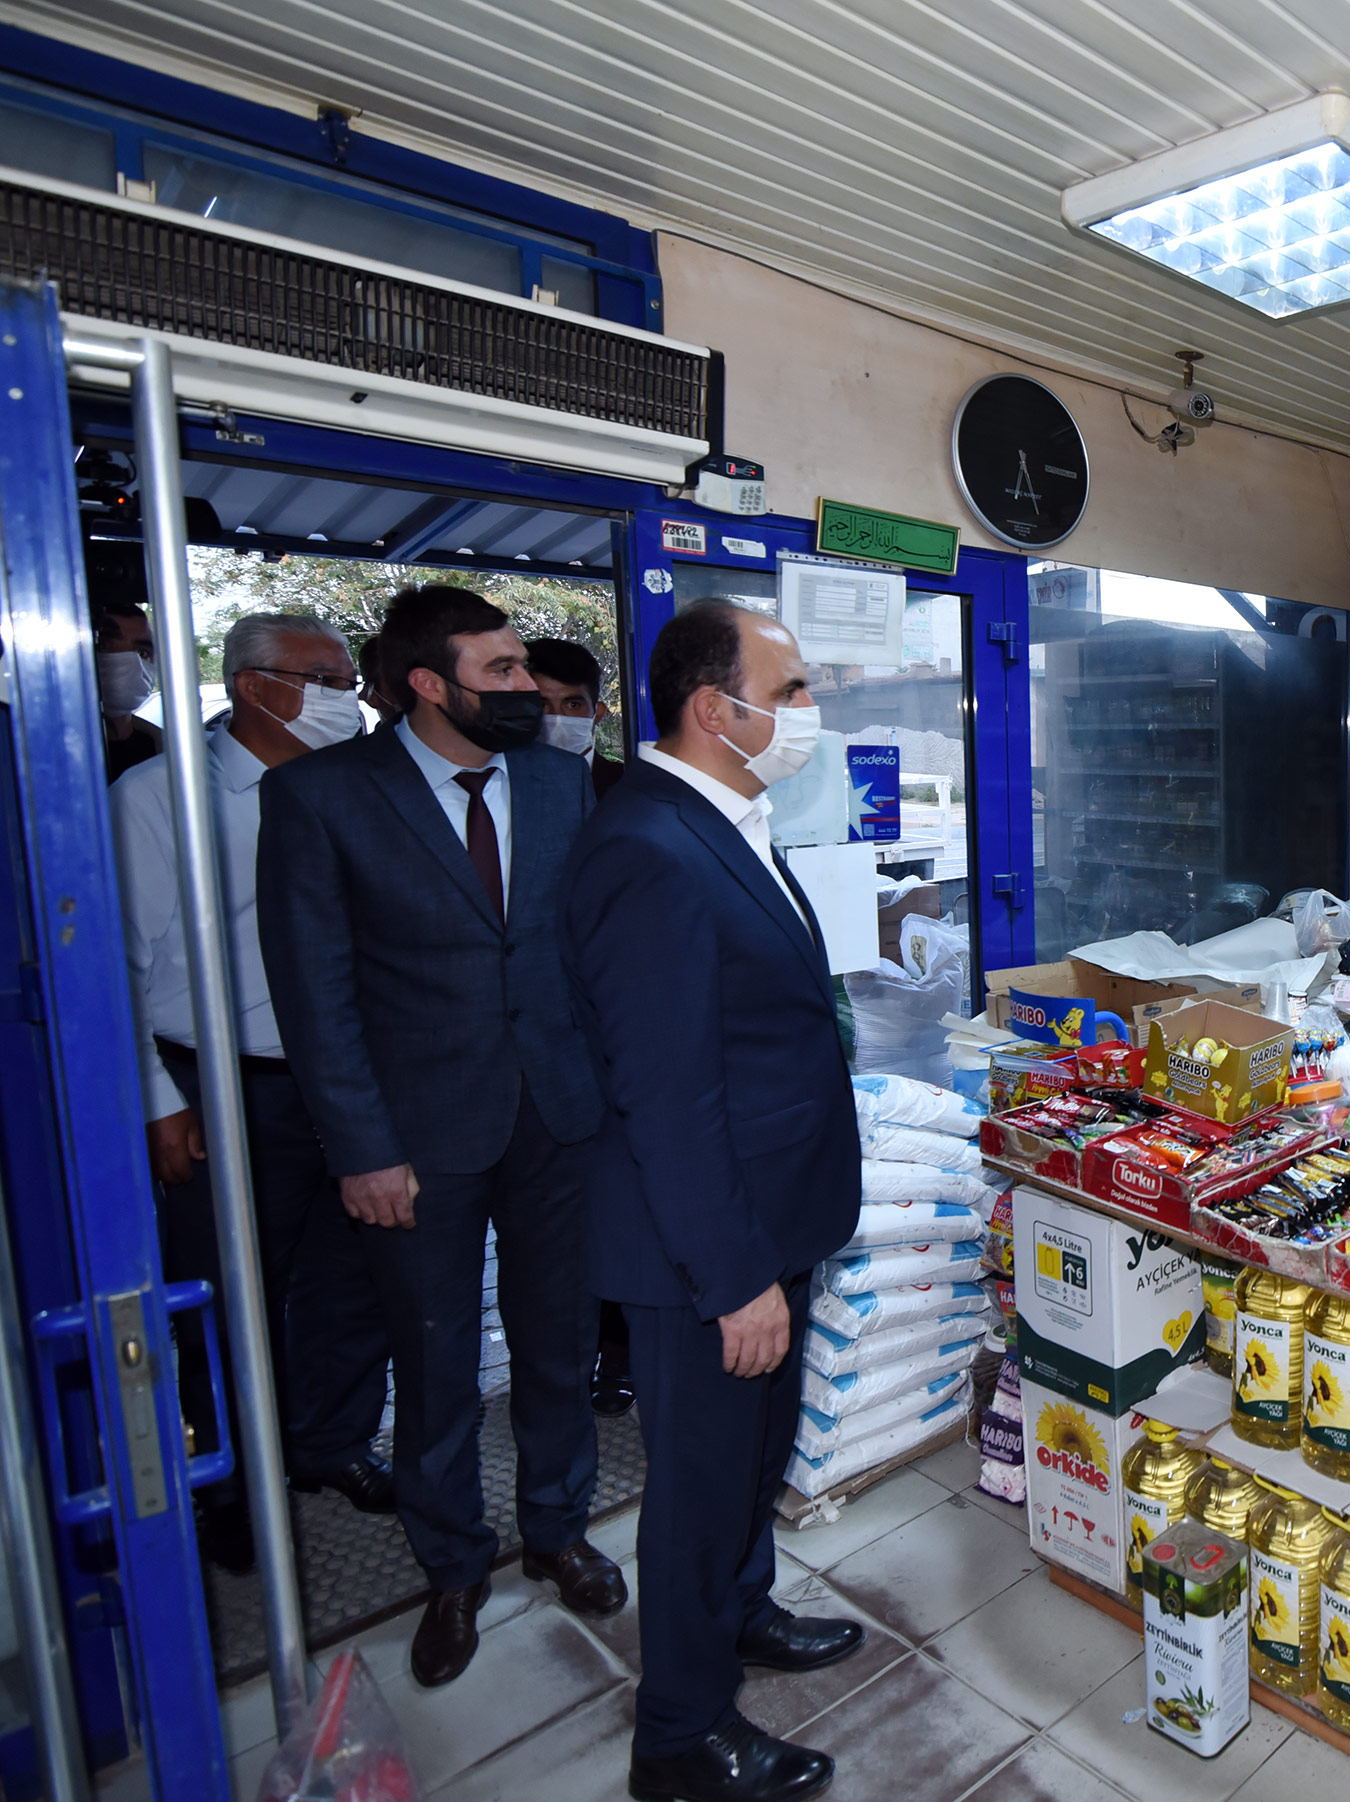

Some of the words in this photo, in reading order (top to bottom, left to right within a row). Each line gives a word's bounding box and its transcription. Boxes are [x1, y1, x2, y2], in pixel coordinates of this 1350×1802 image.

[852, 754, 897, 766] sodexo
[1250, 1040, 1285, 1069] HARIBO
[1168, 1054, 1211, 1080] HARIBO
[1250, 1060, 1281, 1082] Goldbears
[1031, 1071, 1066, 1088] HARIBO
[1169, 1069, 1208, 1090] Goldbears
[1119, 1163, 1156, 1191] Torku
[1042, 1231, 1063, 1248] 4x4,5
[1064, 1236, 1083, 1255] Litre
[1075, 1268, 1084, 1281] 6
[1136, 1256, 1186, 1293] AYÇİÇEK
[1167, 1325, 1182, 1343] 4,5
[1241, 1319, 1283, 1338] yonca
[1307, 1339, 1346, 1362] yonca
[981, 1423, 1023, 1452] HARIBO
[1037, 1446, 1110, 1494] Orkide
[1126, 1495, 1161, 1516] yonca
[1253, 1554, 1292, 1581] yonca
[1146, 1621, 1203, 1659] ZEYTİNBİRLİK
[1154, 1640, 1194, 1673] Riviera
